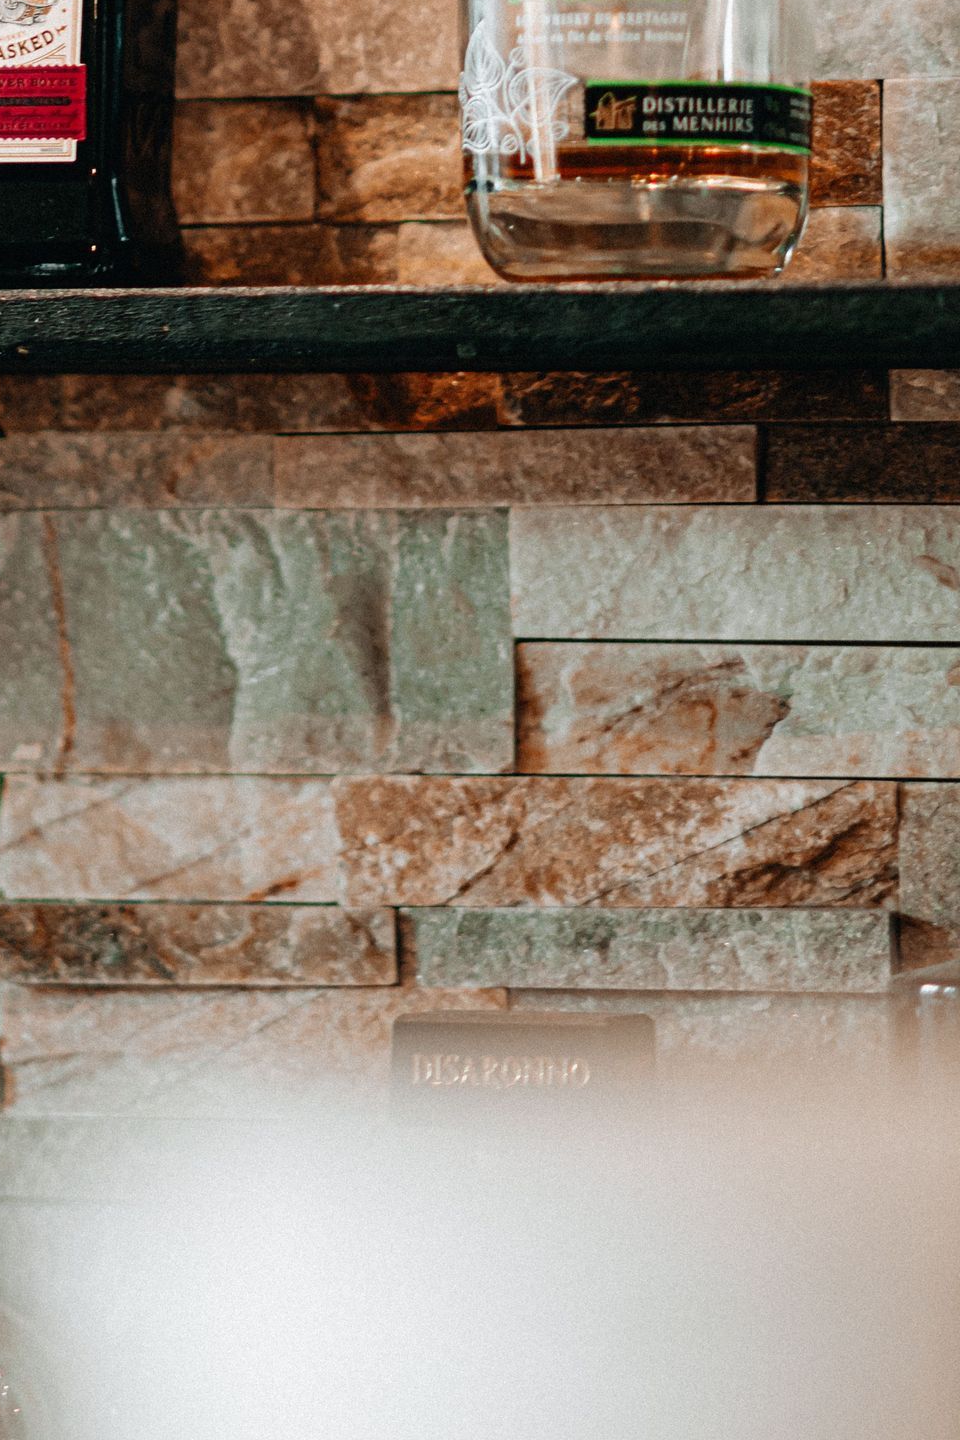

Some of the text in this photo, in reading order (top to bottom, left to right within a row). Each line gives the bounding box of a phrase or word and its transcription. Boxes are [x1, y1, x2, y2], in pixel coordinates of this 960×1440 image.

[642, 95, 754, 114] DISTILLERIE
[642, 115, 754, 133] DES MENHIRS
